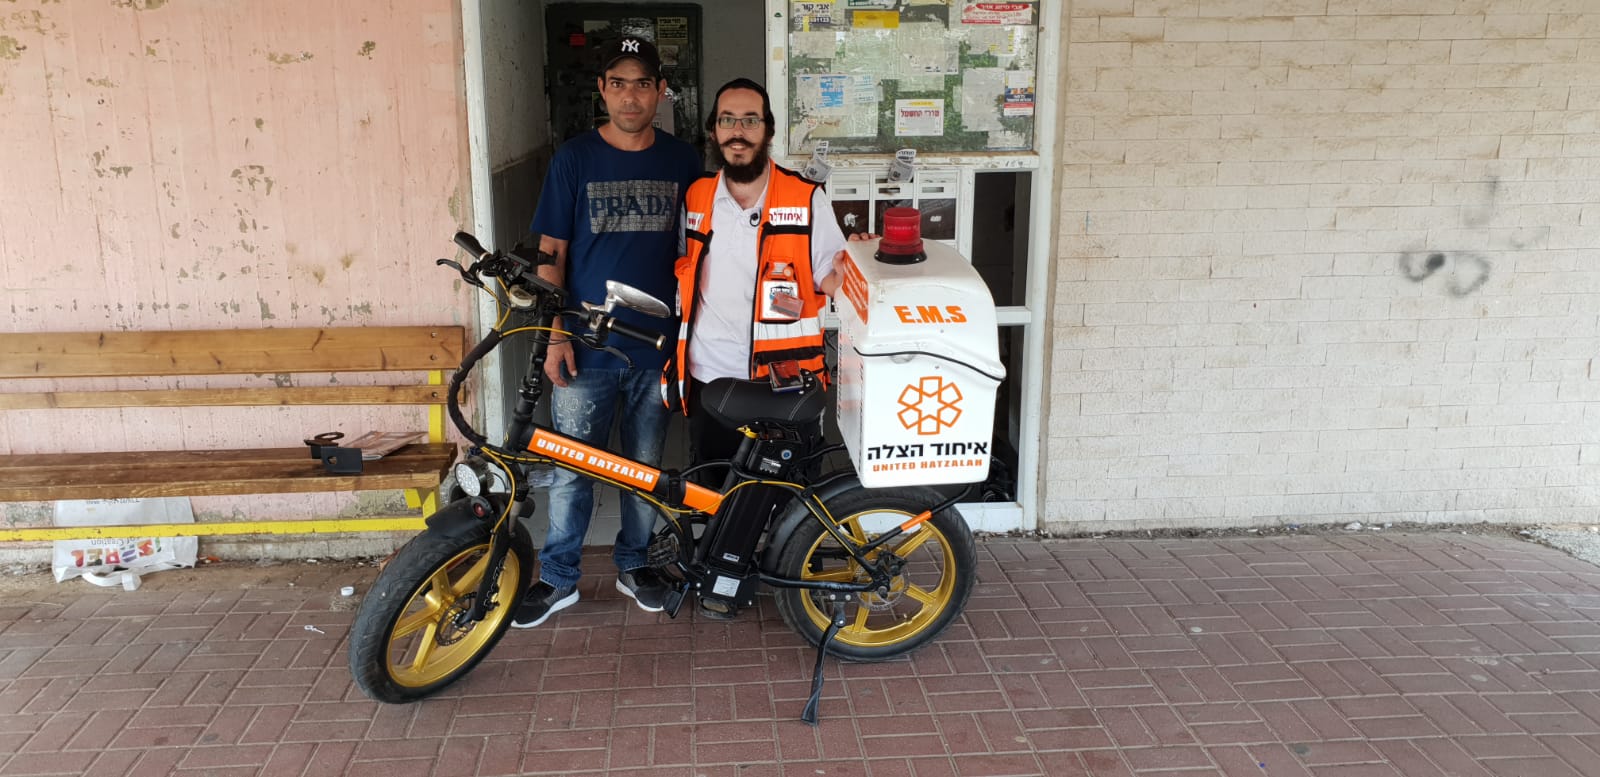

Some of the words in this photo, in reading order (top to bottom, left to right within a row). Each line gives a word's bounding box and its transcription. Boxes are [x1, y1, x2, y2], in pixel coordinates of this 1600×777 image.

[590, 195, 674, 218] PRADA
[894, 305, 967, 324] E.M.S
[867, 443, 924, 461] הצלה
[930, 441, 988, 456] איחוד
[536, 438, 584, 461] UNITED
[587, 455, 654, 483] HATZALAH
[873, 460, 916, 472] UNITED
[920, 458, 983, 470] HATZALAH
